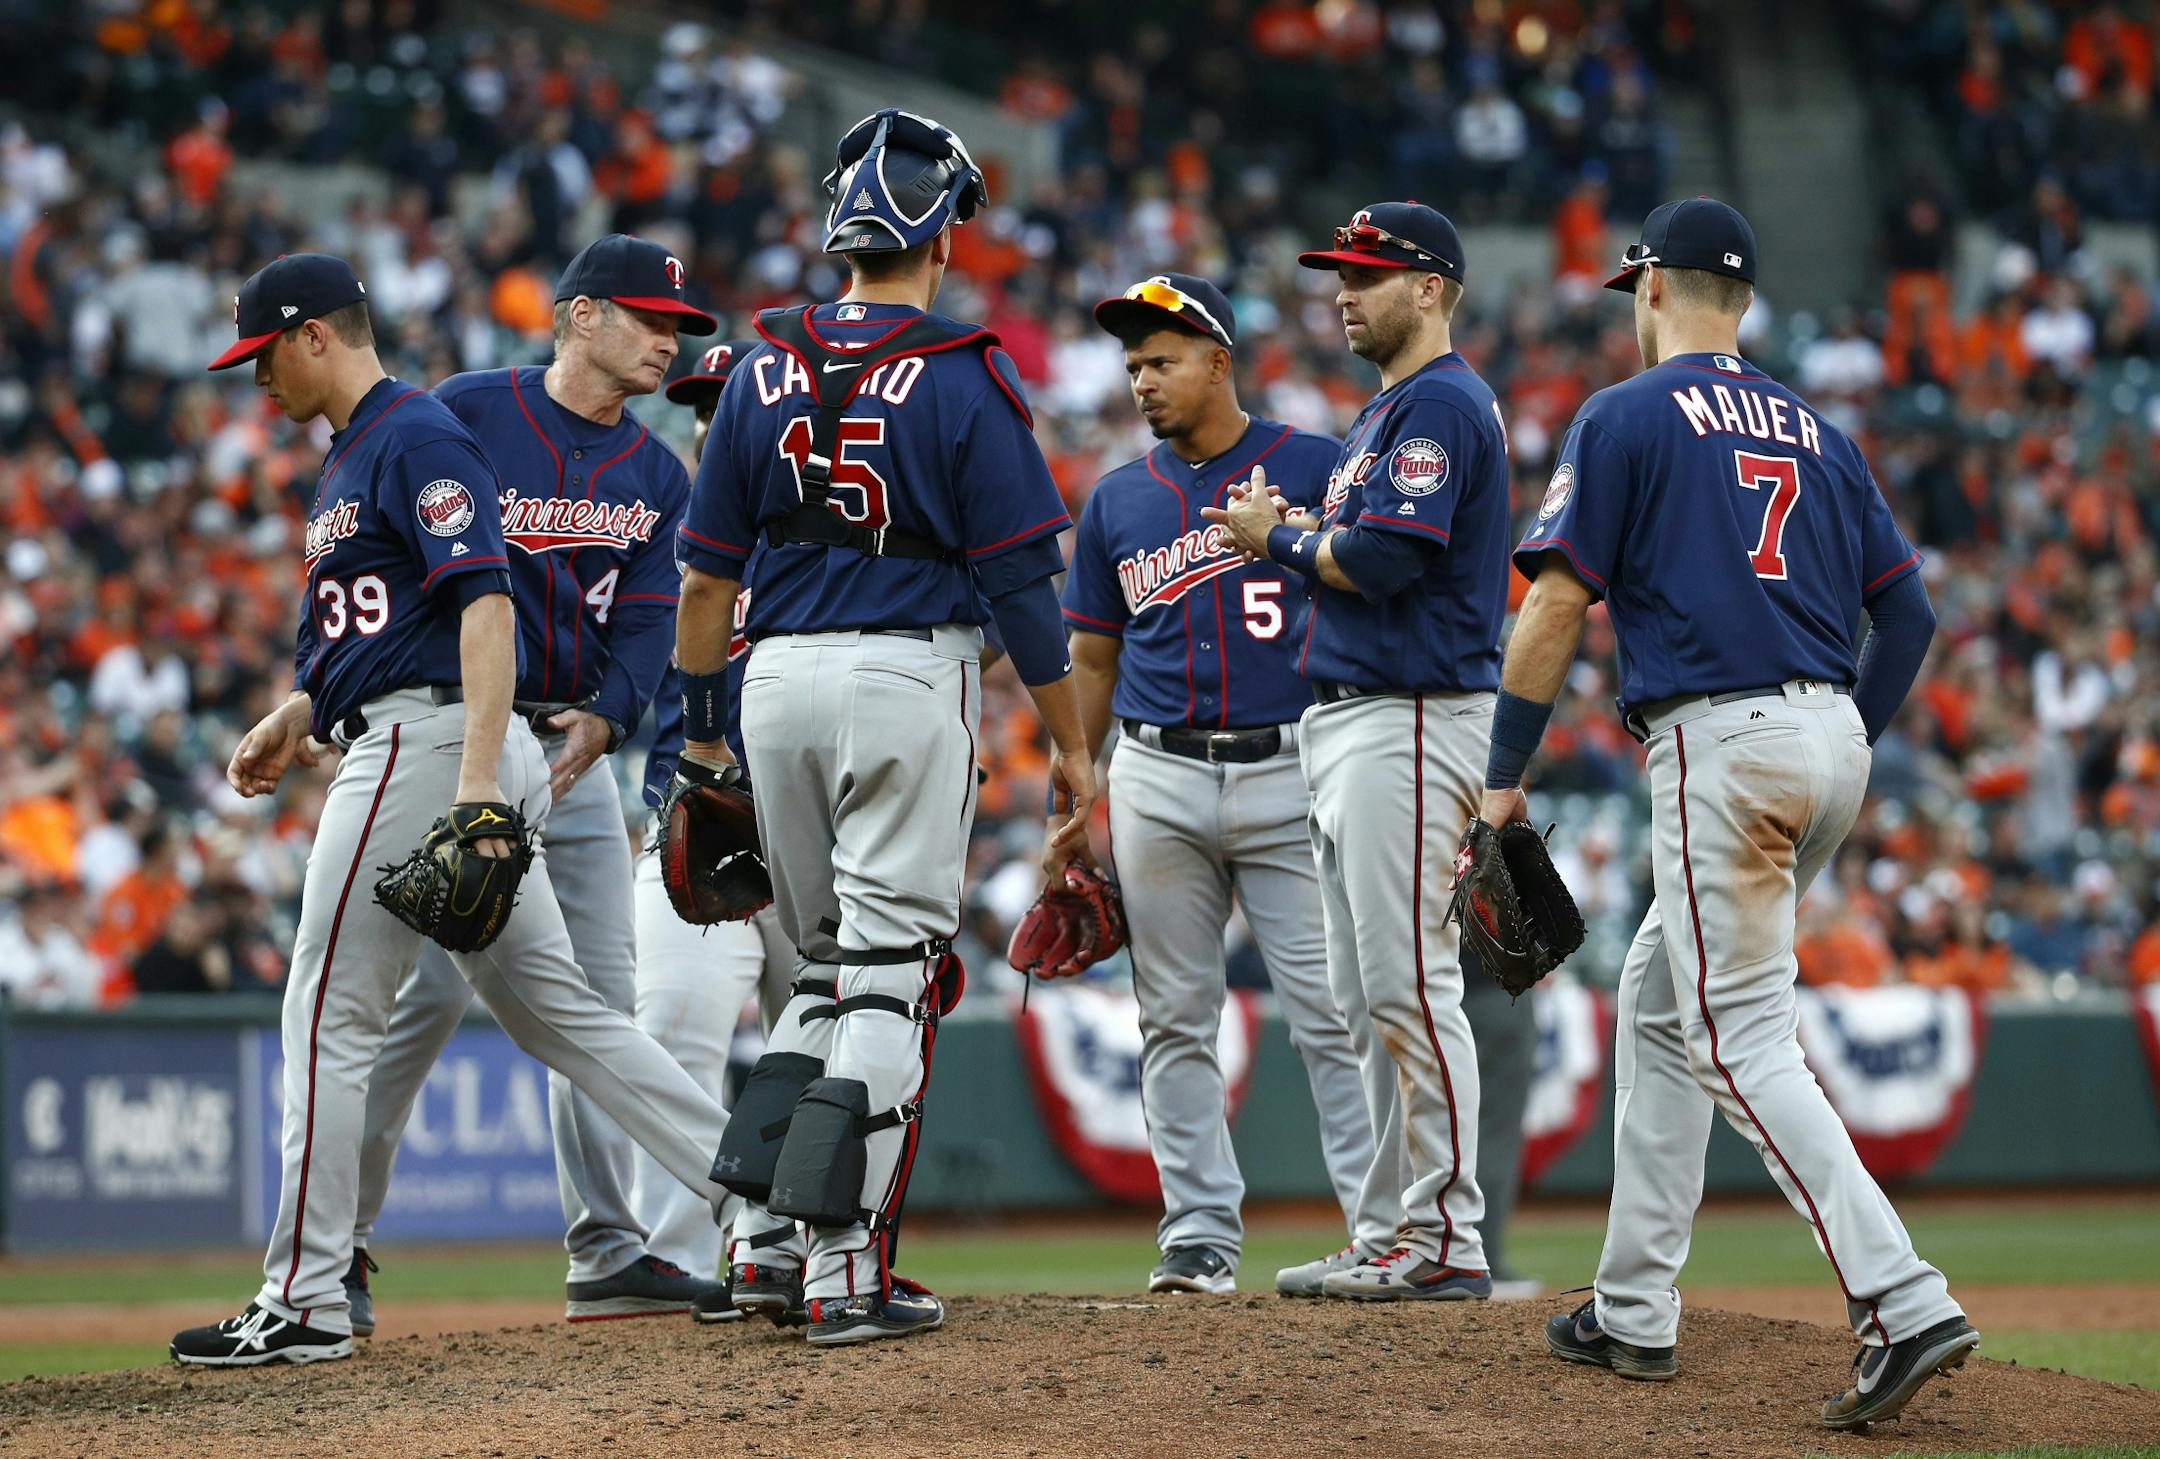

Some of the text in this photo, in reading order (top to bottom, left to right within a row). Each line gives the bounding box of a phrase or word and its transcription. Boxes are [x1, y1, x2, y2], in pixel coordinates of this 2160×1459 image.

[851, 234, 873, 248] 15
[753, 343, 925, 407] CAO
[1671, 384, 1822, 457] MAUER
[1393, 456, 1444, 480] Twins
[1399, 441, 1445, 462] MINNESOTA
[420, 482, 463, 506] MINNESOTA
[421, 491, 468, 526] Twins
[778, 415, 892, 550] 15
[1394, 475, 1438, 494] BASEBALL CLUB
[430, 524, 463, 535] BASEBALL
[499, 487, 661, 543] innesota
[1734, 449, 1801, 581] 7
[585, 566, 620, 625] 4
[1117, 524, 1236, 617] Minne
[318, 573, 390, 640] 39
[1242, 579, 1283, 641] 5
